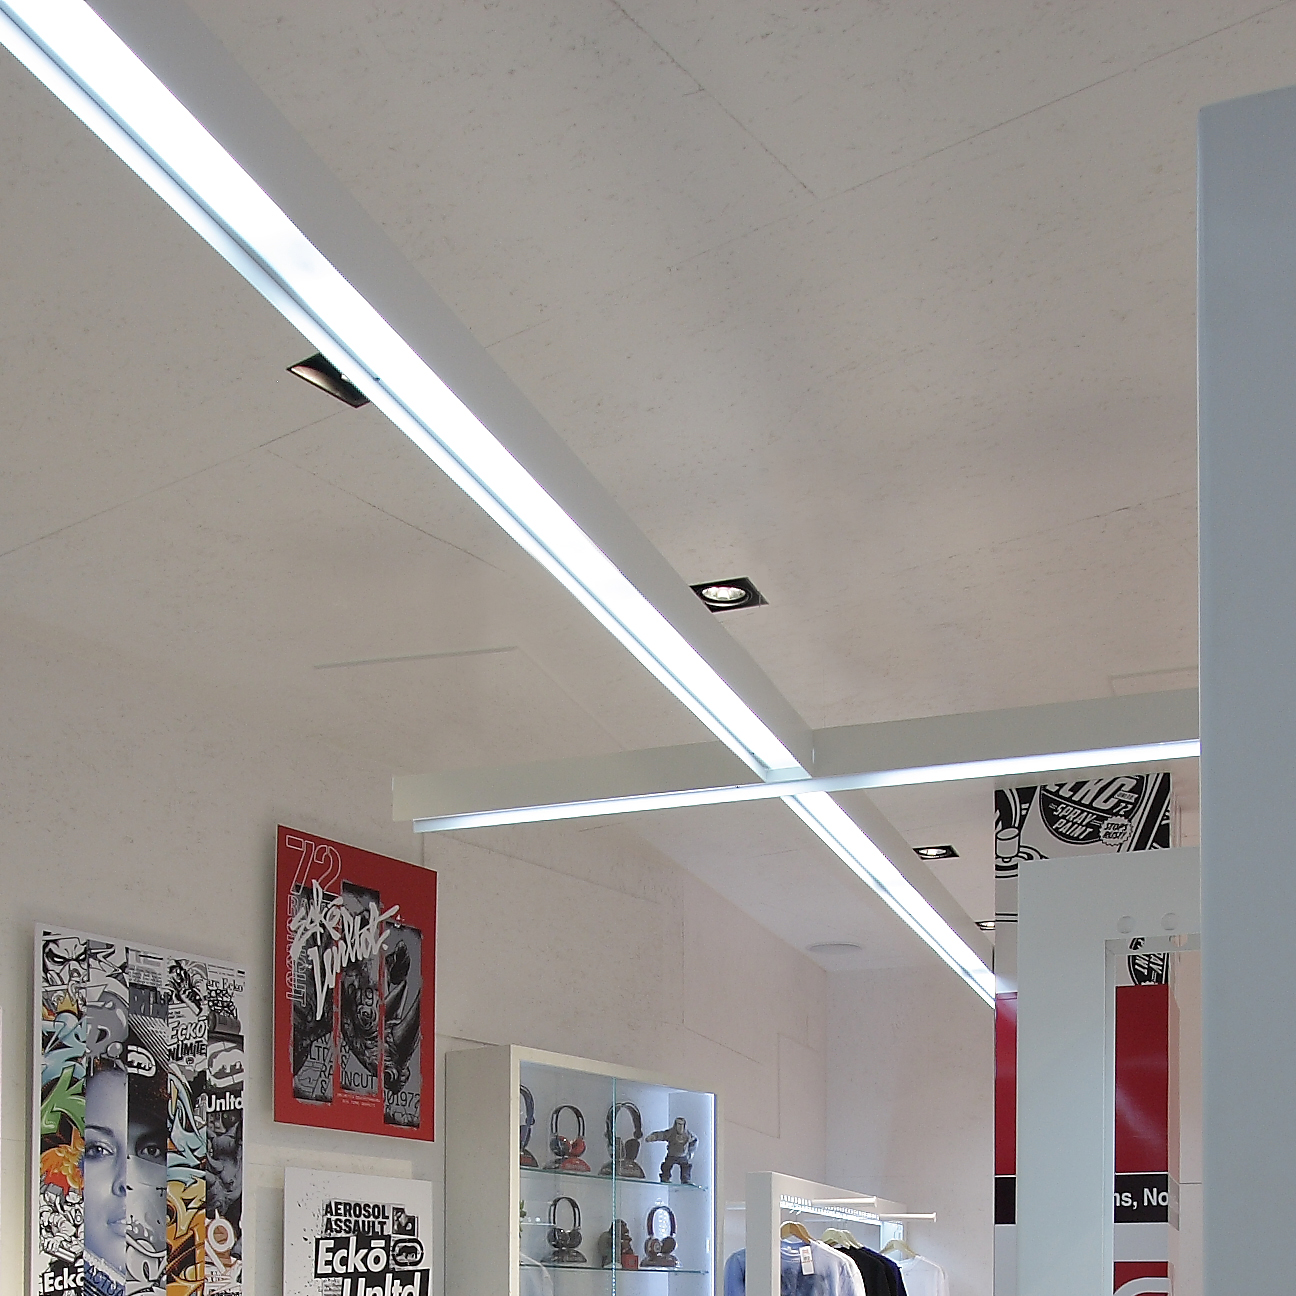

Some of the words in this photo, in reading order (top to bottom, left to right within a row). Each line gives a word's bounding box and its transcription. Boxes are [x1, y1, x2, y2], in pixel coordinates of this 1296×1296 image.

[1053, 804, 1097, 826] SPRAY
[1052, 818, 1094, 839] PAINT
[324, 1201, 390, 1220] AEROSOL
[324, 1218, 387, 1236] ASSAULT
